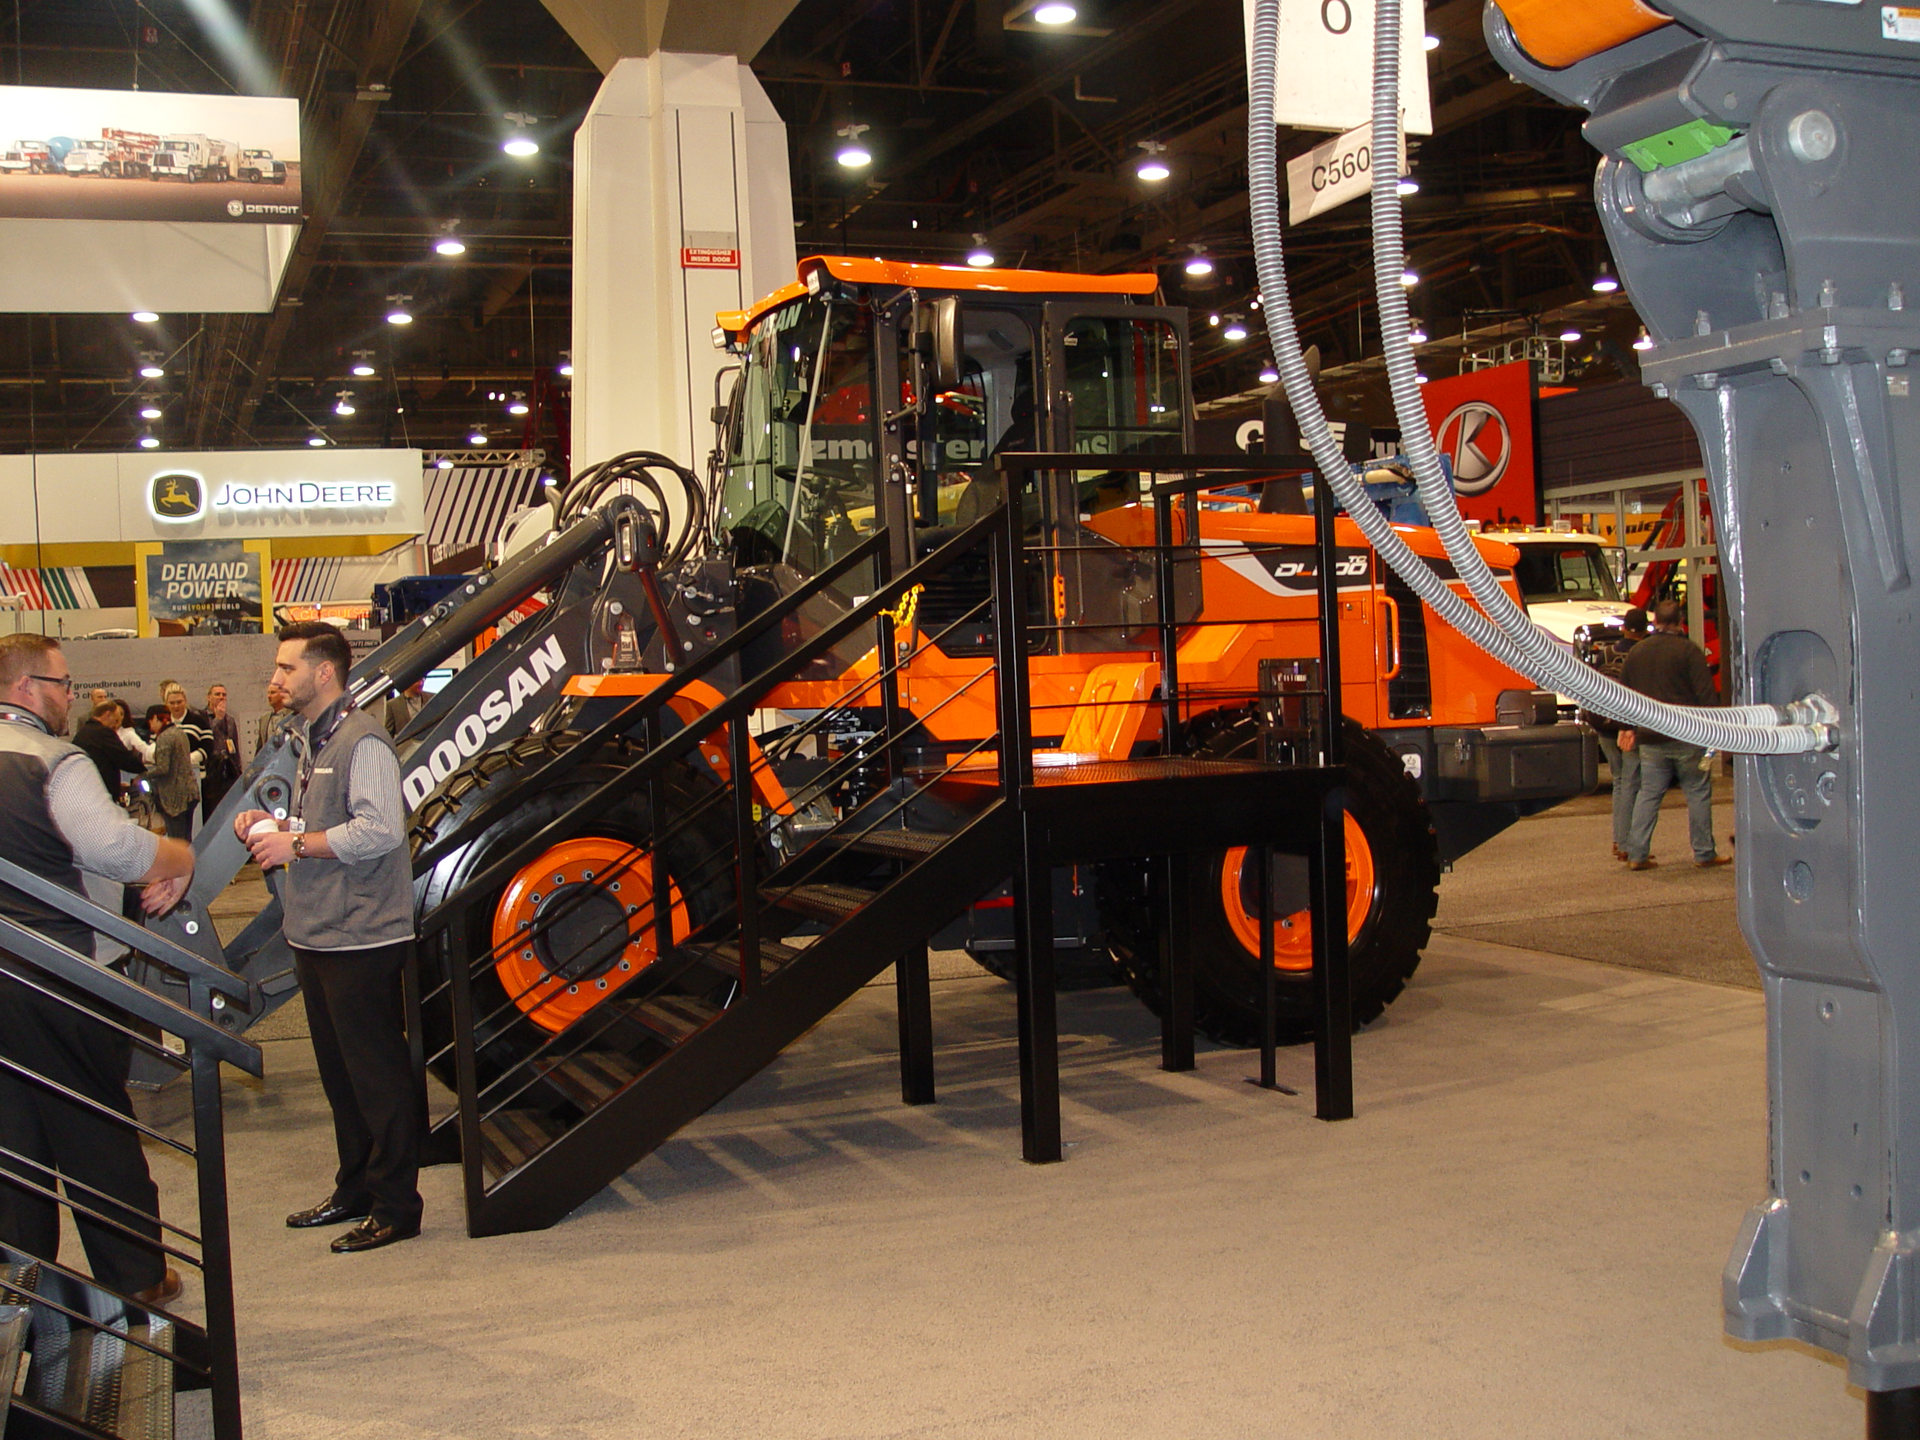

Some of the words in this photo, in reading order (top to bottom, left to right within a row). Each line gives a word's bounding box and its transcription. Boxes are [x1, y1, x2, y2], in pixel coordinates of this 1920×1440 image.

[246, 204, 299, 214] DETROIT
[689, 248, 732, 256] EXTINGUISHER
[216, 483, 293, 506] JOHN
[299, 482, 392, 503] DEERE
[161, 561, 249, 581] DEMAND
[1274, 561, 1368, 577] DL00
[1348, 555, 1368, 563] TC
[166, 580, 243, 599] POWER.
[73, 679, 141, 690] groundbreaking
[402, 633, 567, 812] DOOSAN
